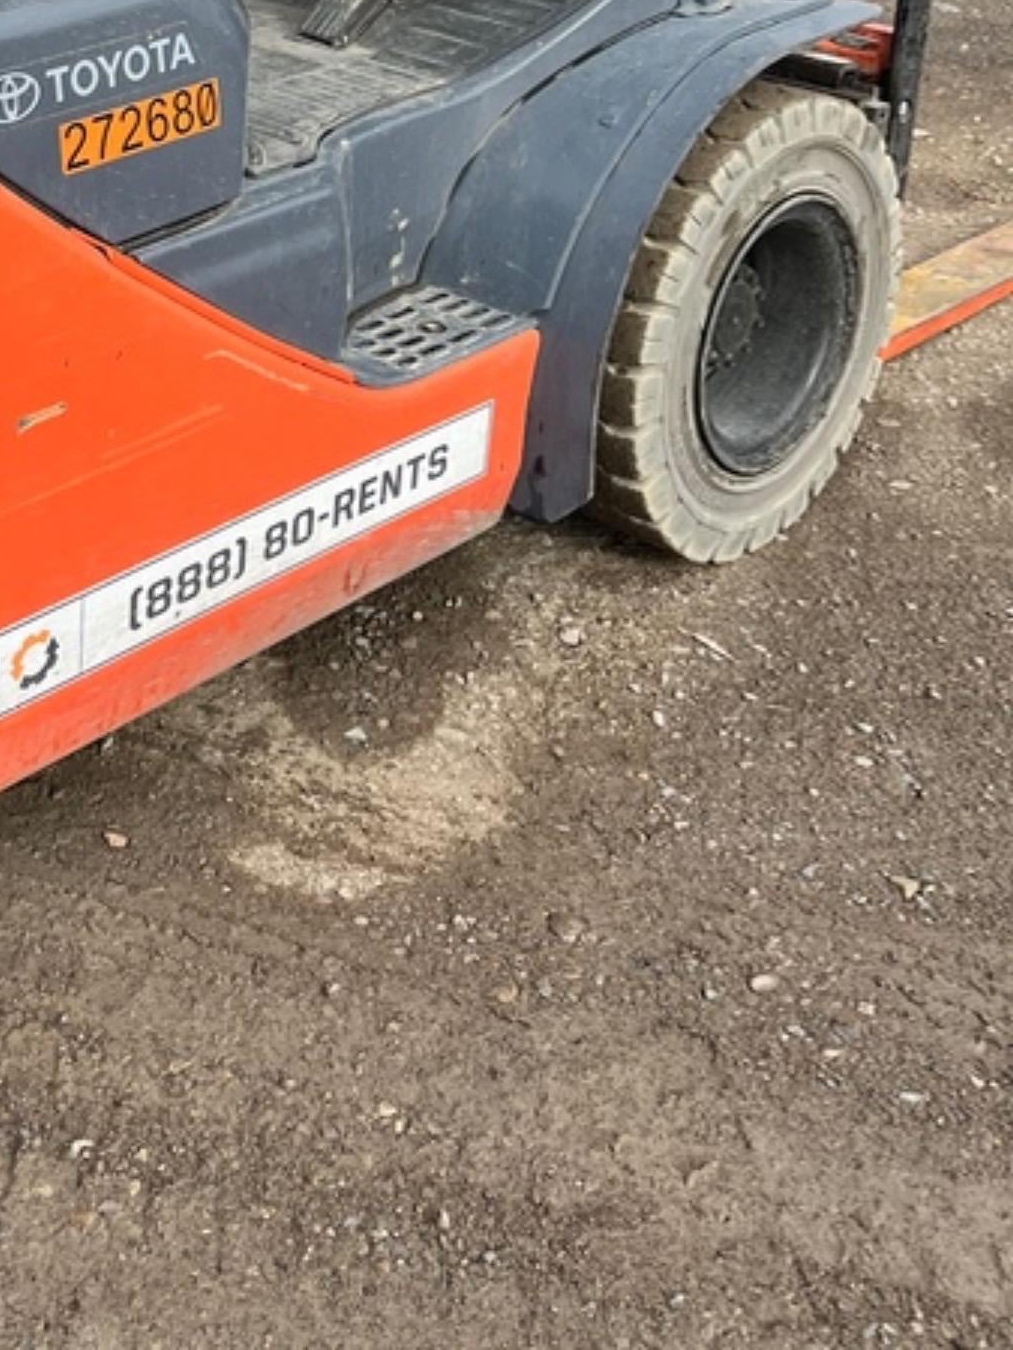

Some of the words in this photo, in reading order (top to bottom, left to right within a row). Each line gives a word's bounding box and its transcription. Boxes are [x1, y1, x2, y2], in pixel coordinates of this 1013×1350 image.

[45, 32, 195, 102] TOYOTA
[63, 82, 217, 171] 272680
[128, 536, 248, 631] (888)
[262, 443, 449, 562] 80-RENTS
